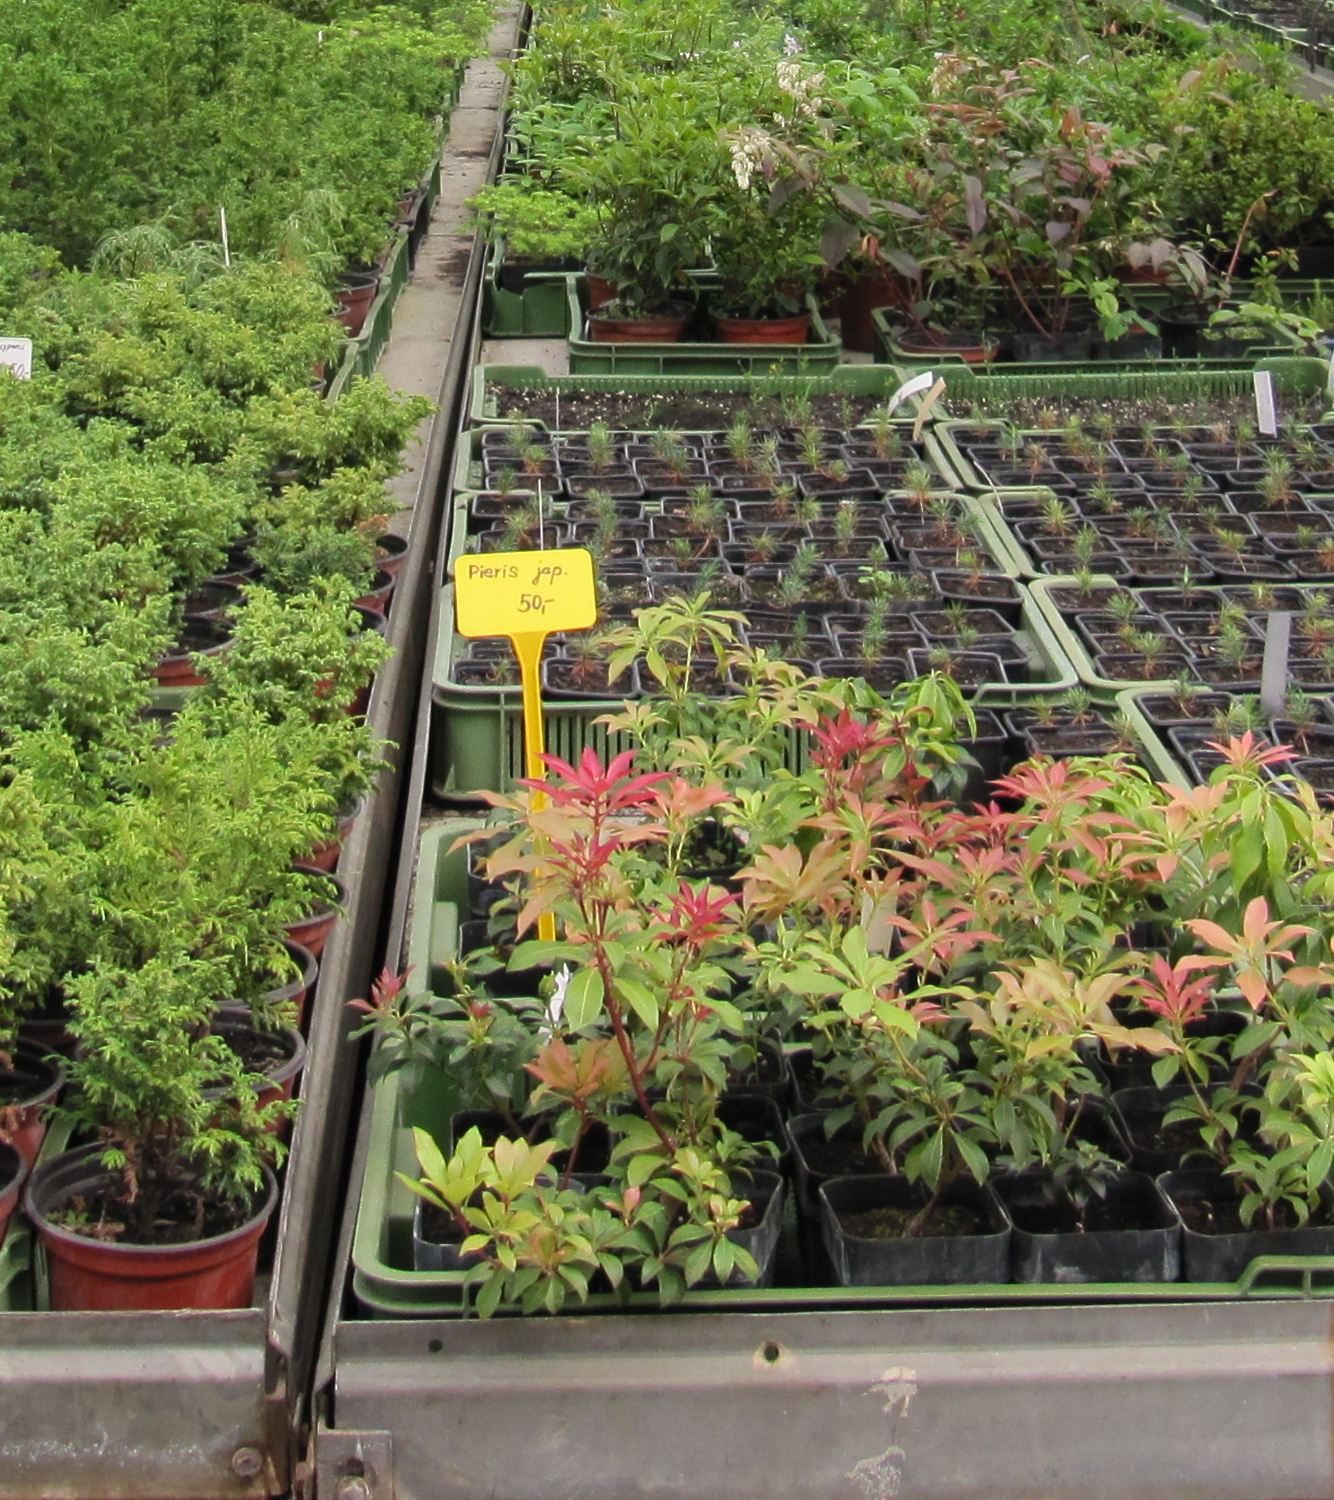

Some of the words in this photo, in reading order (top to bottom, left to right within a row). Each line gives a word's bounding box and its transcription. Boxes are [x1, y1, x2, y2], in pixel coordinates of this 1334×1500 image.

[468, 564, 519, 580] Pieris
[531, 560, 568, 586] jap.
[517, 593, 555, 615] 50,-
